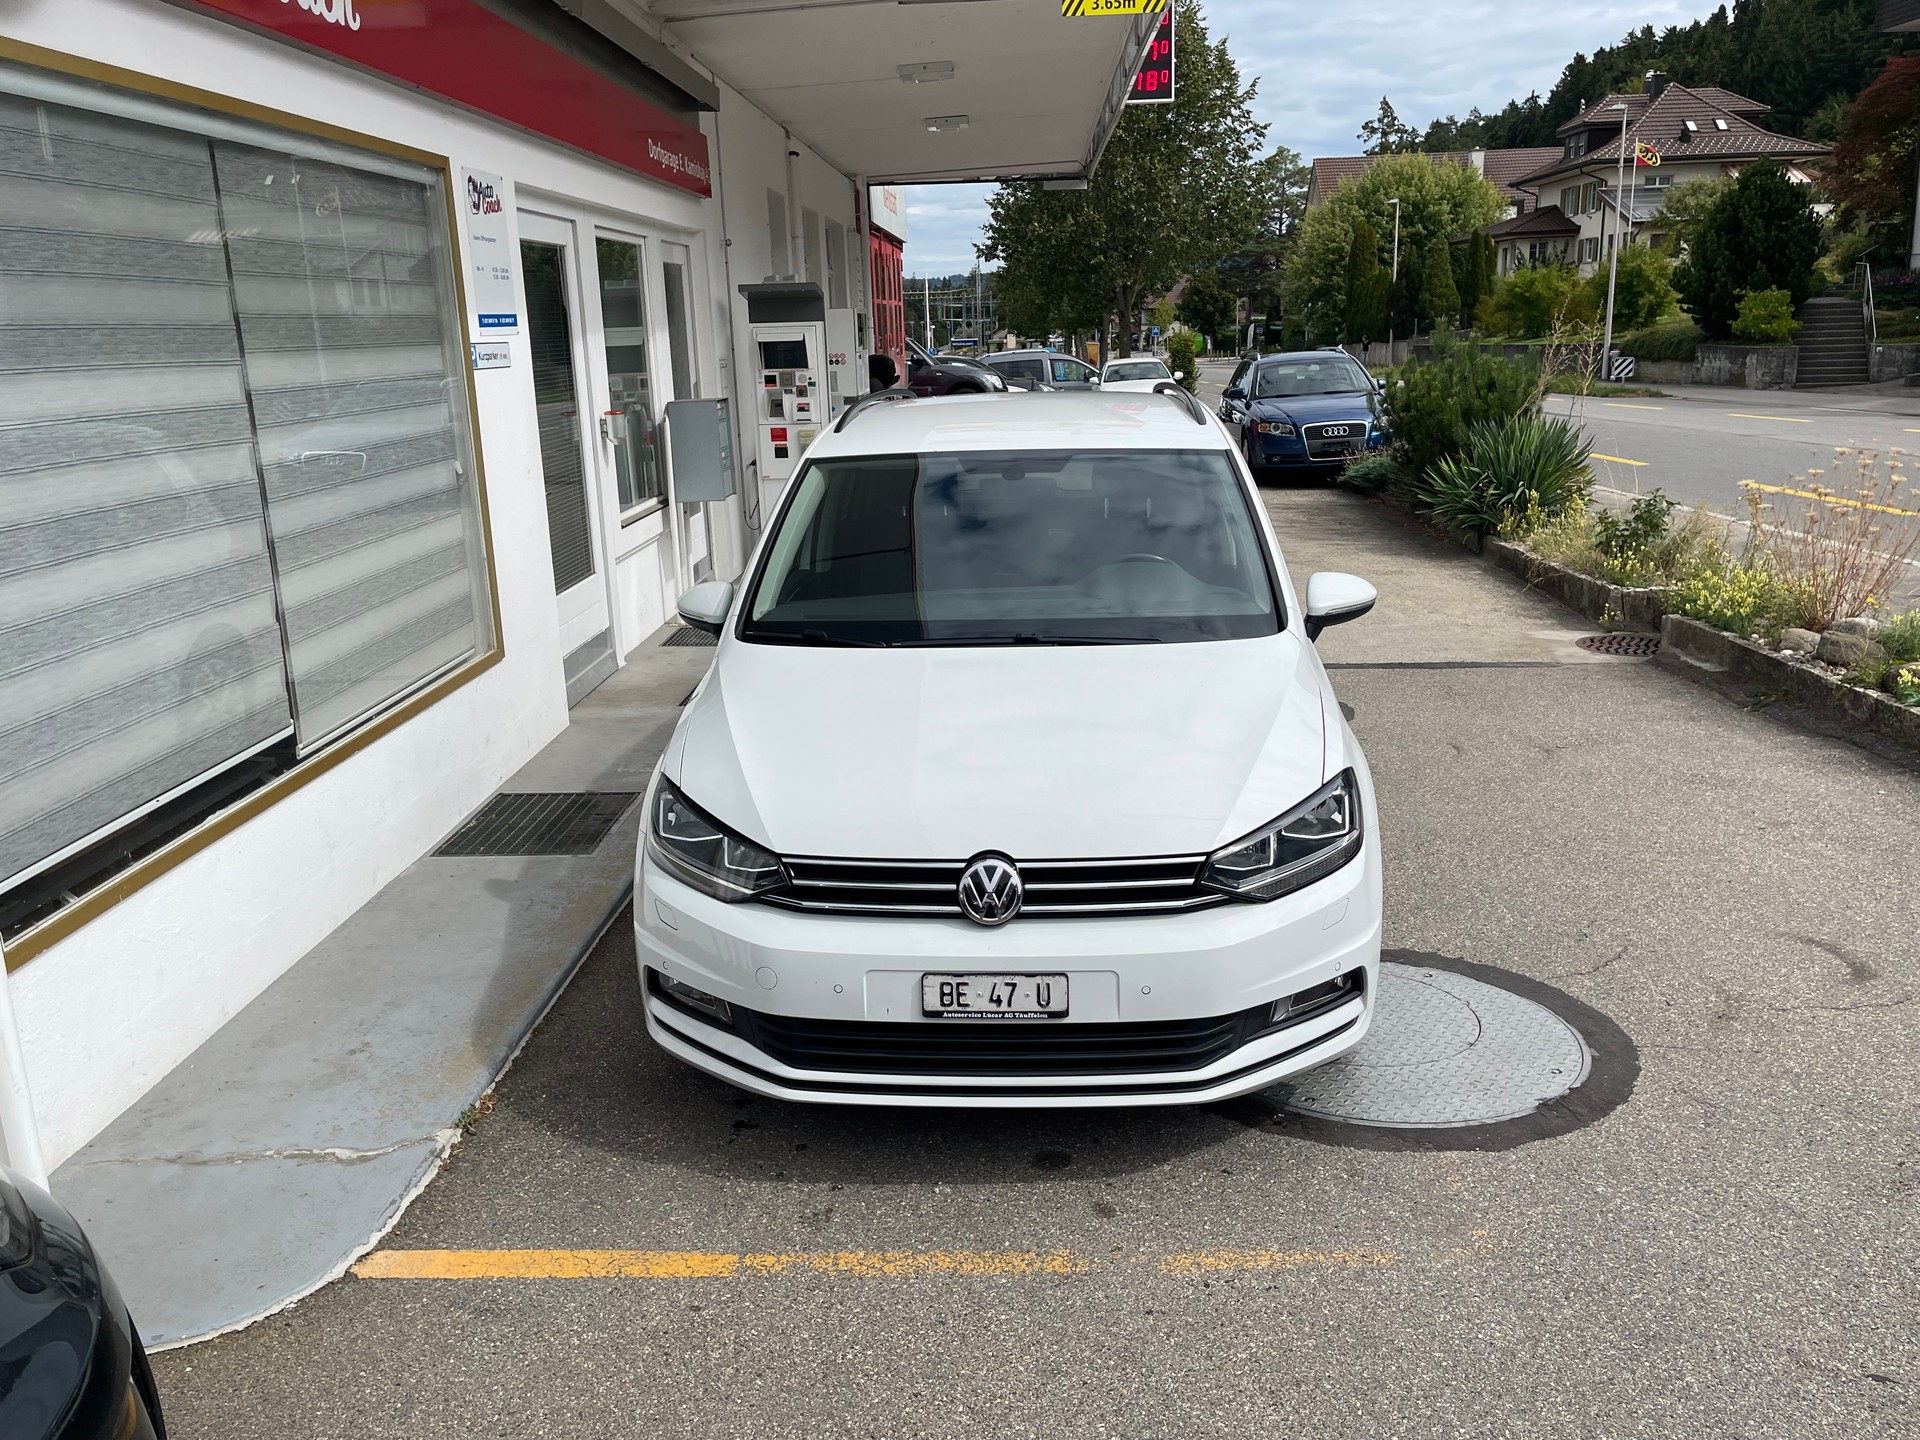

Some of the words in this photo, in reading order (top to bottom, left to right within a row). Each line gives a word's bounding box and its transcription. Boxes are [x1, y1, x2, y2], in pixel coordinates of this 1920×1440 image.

[1092, 0, 1135, 10] 3.65m
[647, 137, 679, 174] Dorfgarage
[482, 194, 502, 215] Coach
[939, 981, 970, 1008] BE
[988, 981, 1018, 1008] 47
[1036, 982, 1052, 1009] U
